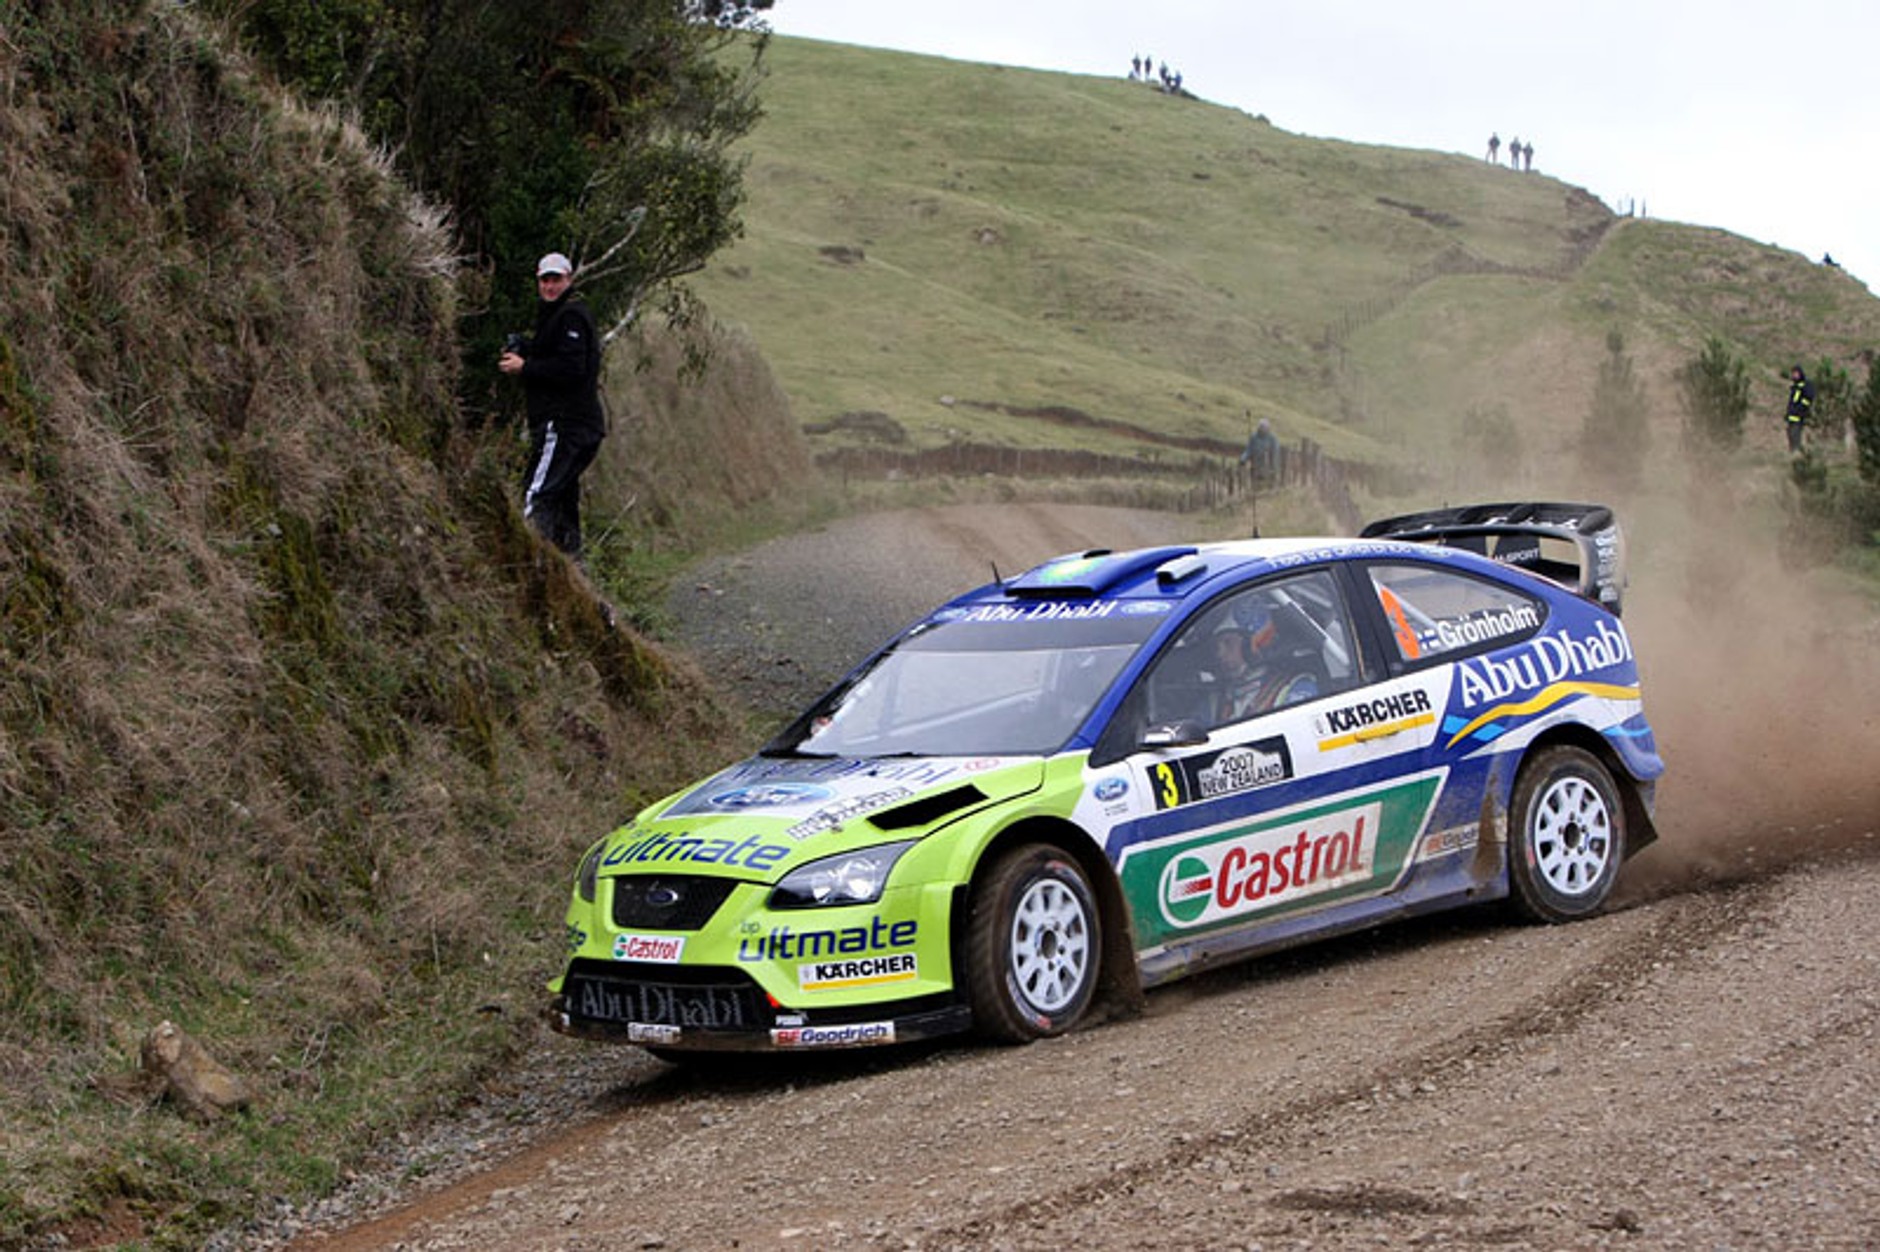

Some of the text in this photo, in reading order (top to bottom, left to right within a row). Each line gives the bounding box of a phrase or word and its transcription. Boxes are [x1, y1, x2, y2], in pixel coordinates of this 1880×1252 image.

[965, 605, 1024, 621] Abu
[1437, 604, 1540, 647] Grönholm
[1459, 654, 1540, 708] Abu
[1325, 688, 1432, 735] KÄRCHER
[1156, 762, 1179, 808] 3
[1220, 752, 1254, 774] 2007
[1202, 776, 1228, 795] NEW
[1216, 815, 1365, 909] Castrol
[627, 937, 681, 960] Castrol
[582, 980, 743, 1028] Abu Dhabi
